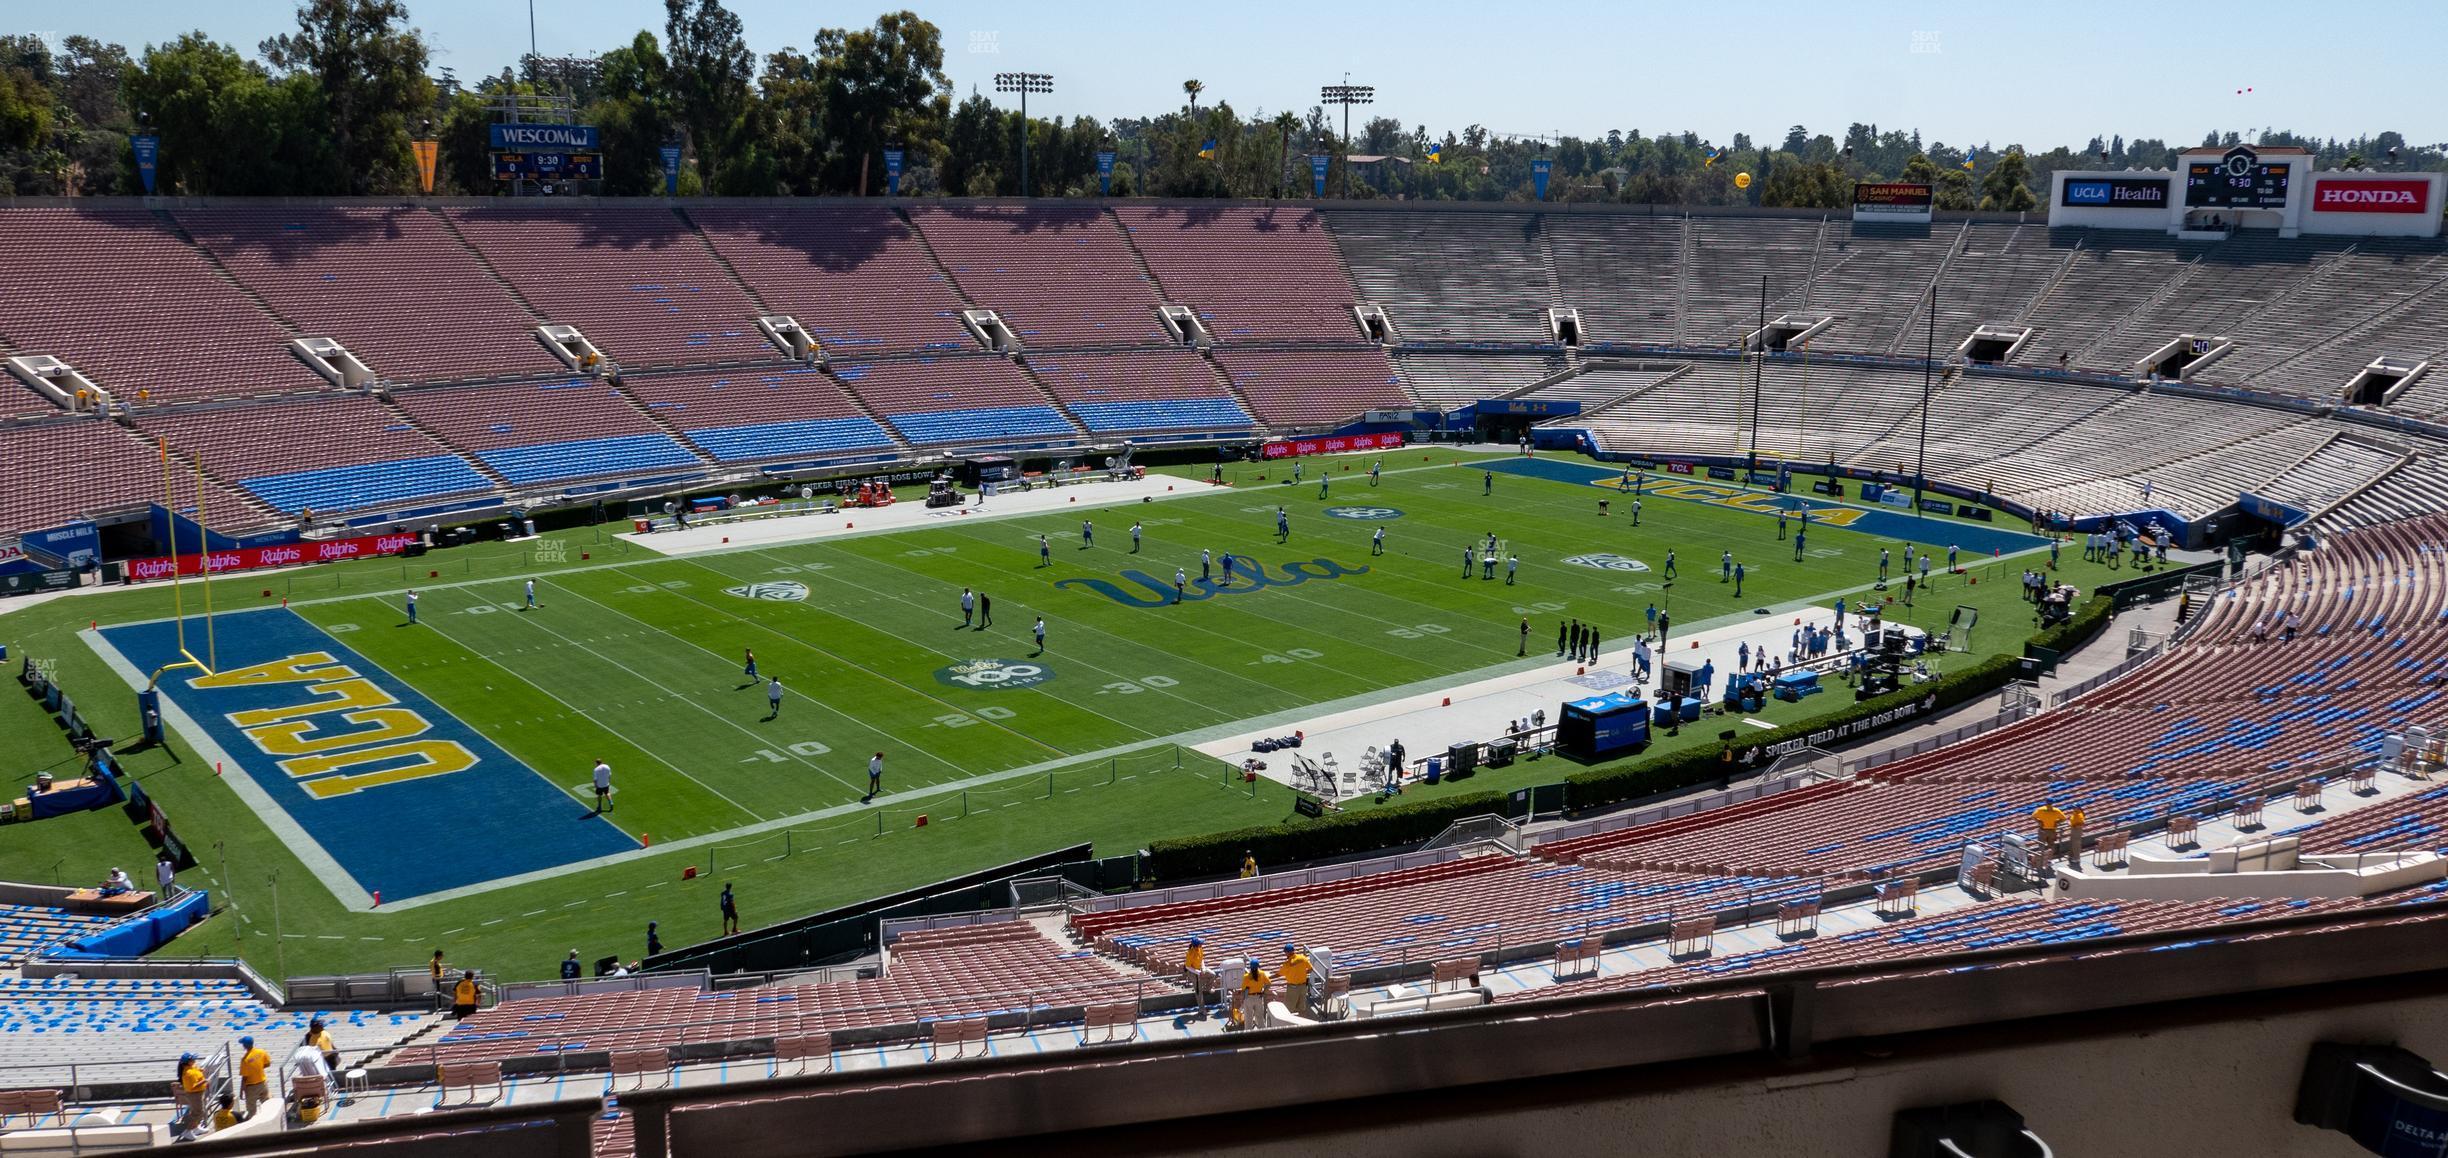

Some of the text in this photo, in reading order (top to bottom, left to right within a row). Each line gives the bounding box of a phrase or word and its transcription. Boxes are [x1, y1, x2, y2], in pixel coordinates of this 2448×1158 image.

[502, 129, 570, 143] WESCOM
[537, 156, 559, 165] 9:30
[509, 163, 517, 172] 0
[580, 164, 588, 173] 0
[2213, 167, 2220, 175] 0
[2261, 167, 2268, 175] 0
[2280, 179, 2287, 187] 3
[1870, 187, 1889, 195] SAN
[2074, 187, 2161, 200] UCLA Health
[2321, 190, 2417, 203] HONDA
[2192, 340, 2209, 354] 40
[1325, 440, 1345, 450] Ralphs
[1353, 436, 1372, 448] Ralphs
[1381, 432, 1400, 445] Ralphs
[1267, 445, 1287, 456] Ralphs
[1296, 442, 1317, 453] Ralphs
[1671, 463, 1688, 472] TCL
[891, 473, 911, 482] ROSE
[913, 471, 935, 479] BOWL
[1590, 473, 1869, 527] UCLA
[46, 526, 94, 543] MUSCLE MILK
[261, 547, 300, 564] Ralphs
[320, 542, 358, 557] Ralphs
[1386, 624, 1452, 639] 50
[1262, 648, 1324, 664] 40
[951, 665, 1041, 686] 100
[1103, 675, 1180, 694] 30
[933, 706, 1017, 728] 20
[185, 651, 481, 800] UCLA
[1765, 703, 1917, 758] SPIEKER FIELD AT THE ROSE BOWL
[756, 741, 833, 763] 10
[2395, 1120, 2434, 1140] DELTA
